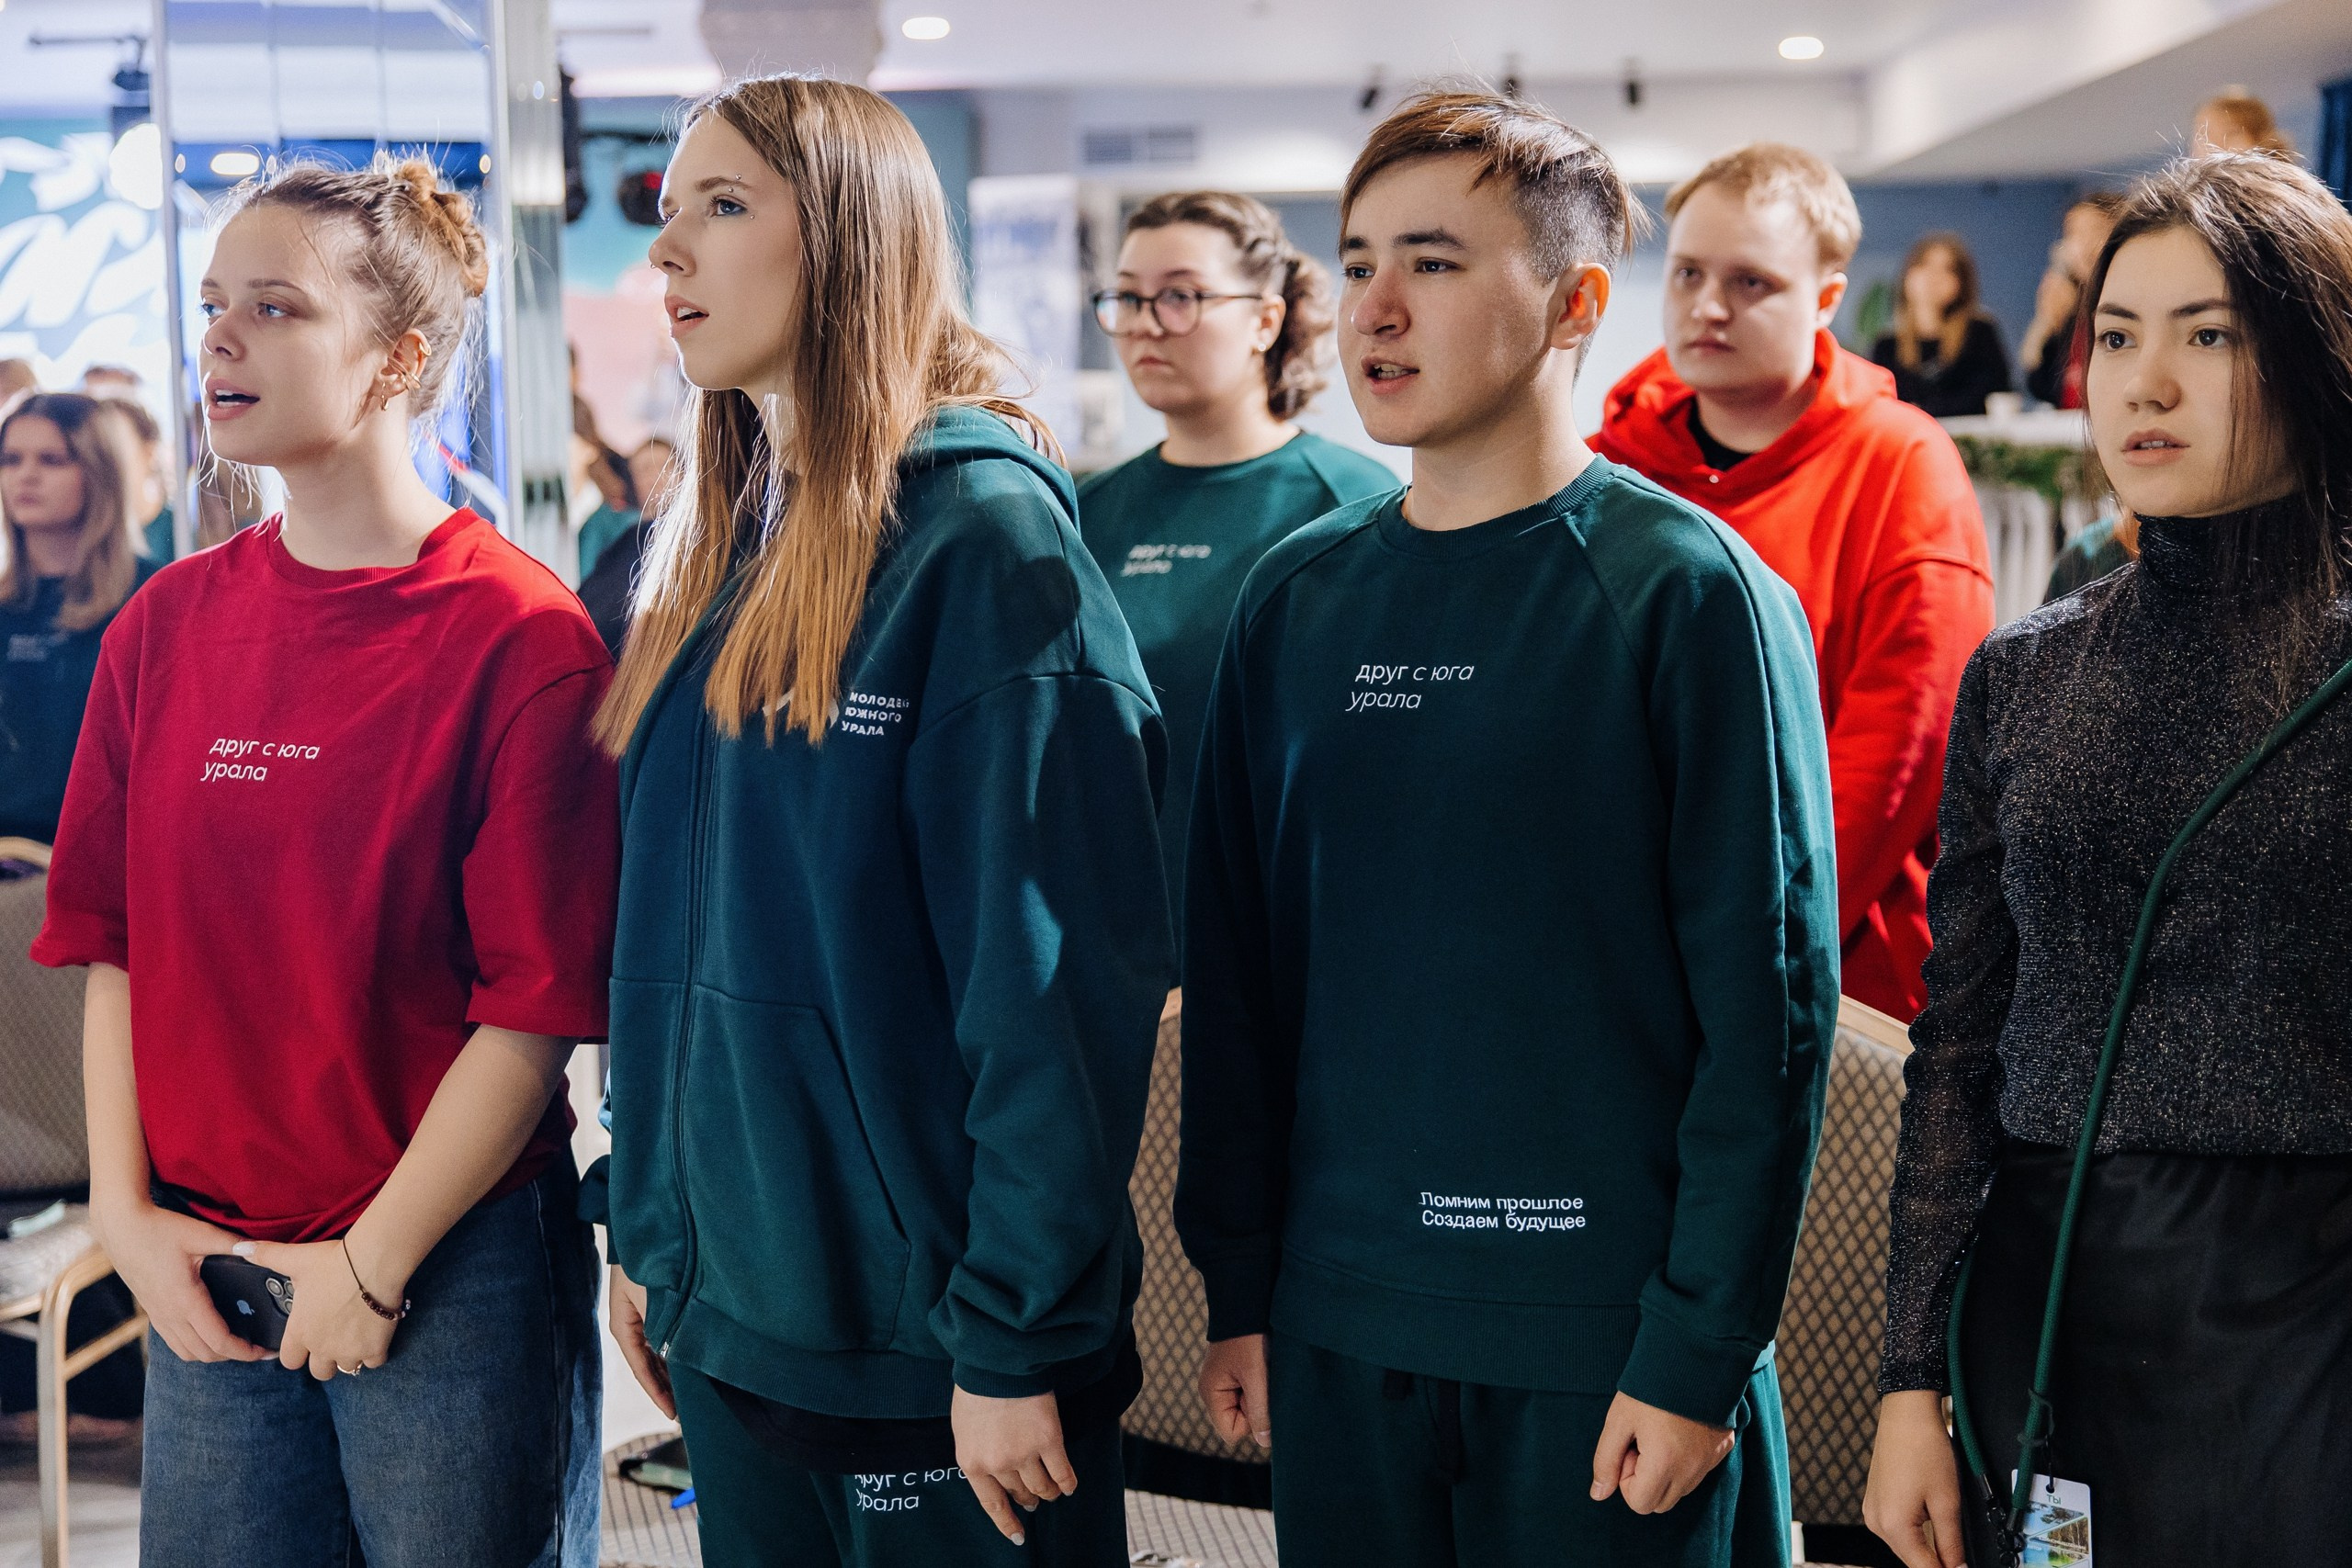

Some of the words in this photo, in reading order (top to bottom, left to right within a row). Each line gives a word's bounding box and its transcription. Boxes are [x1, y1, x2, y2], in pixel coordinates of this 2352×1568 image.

[1354, 664, 1408, 685] друг
[1412, 666, 1427, 681] с
[1430, 665, 1475, 681] юга
[1345, 691, 1422, 712] урала
[844, 706, 902, 723] ЮЖНОГО
[841, 720, 885, 736] УРАЛА
[209, 738, 260, 759] друг
[262, 742, 276, 756] с
[277, 743, 321, 760] юга
[200, 761, 268, 783] урала
[1497, 1197, 1584, 1213] прошлое
[1422, 1210, 1498, 1229] Создаем
[1505, 1213, 1586, 1232] будущее
[903, 1472, 917, 1486] с
[855, 1488, 920, 1512] урала
